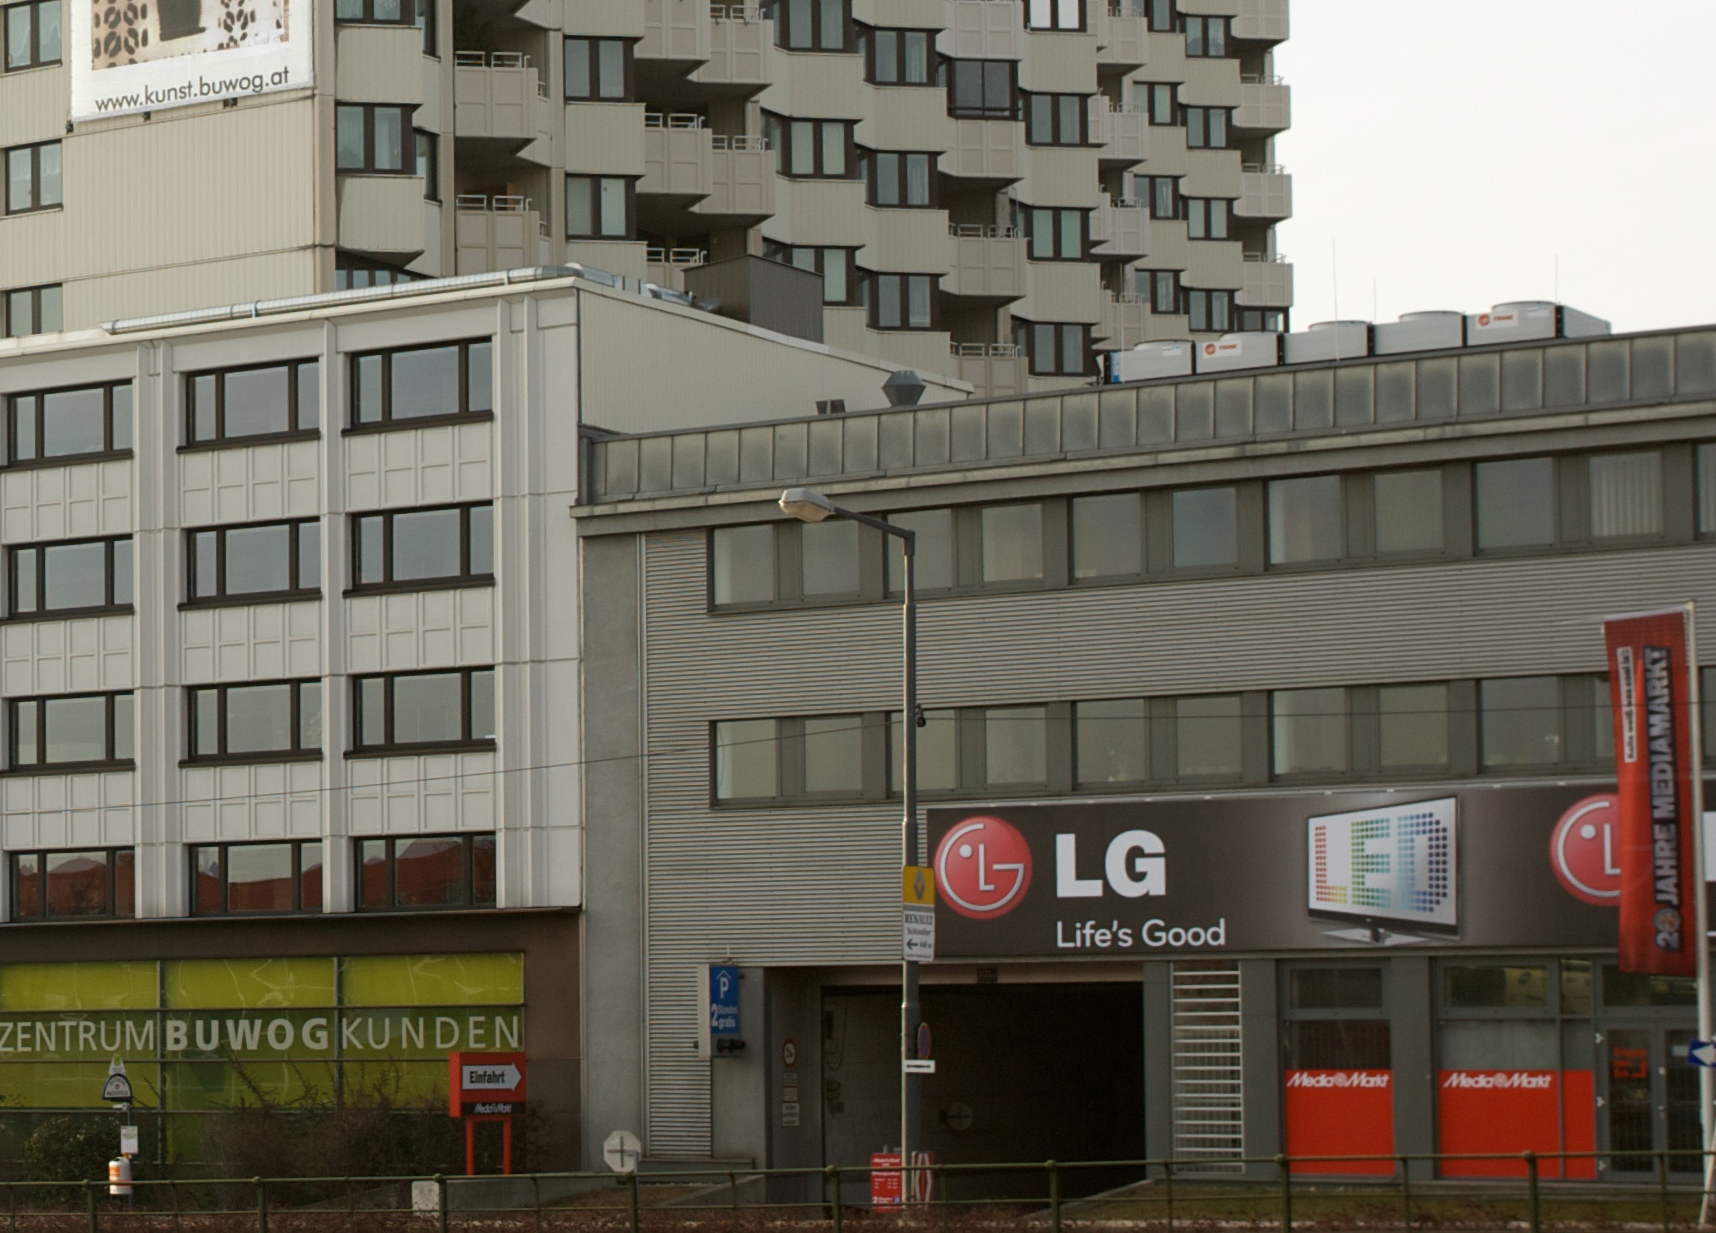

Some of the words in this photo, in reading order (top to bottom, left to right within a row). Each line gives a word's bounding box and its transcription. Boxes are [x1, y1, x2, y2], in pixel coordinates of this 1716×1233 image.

[95, 66, 290, 112] www.kunst.buwog.at
[1645, 647, 1676, 819] MEDIAMARKT
[1055, 829, 1166, 898] LG
[1315, 812, 1448, 913] LED
[1654, 823, 1680, 906] JAHRE
[905, 914, 933, 926] RENAULT
[1057, 920, 1133, 947] Life's
[1142, 917, 1226, 947] Good
[720, 978, 729, 999] P
[165, 1017, 328, 1051] BUWOG
[341, 1015, 519, 1049] KUNDEN
[711, 1003, 718, 1027] 2
[469, 1070, 505, 1084] Einfahrt
